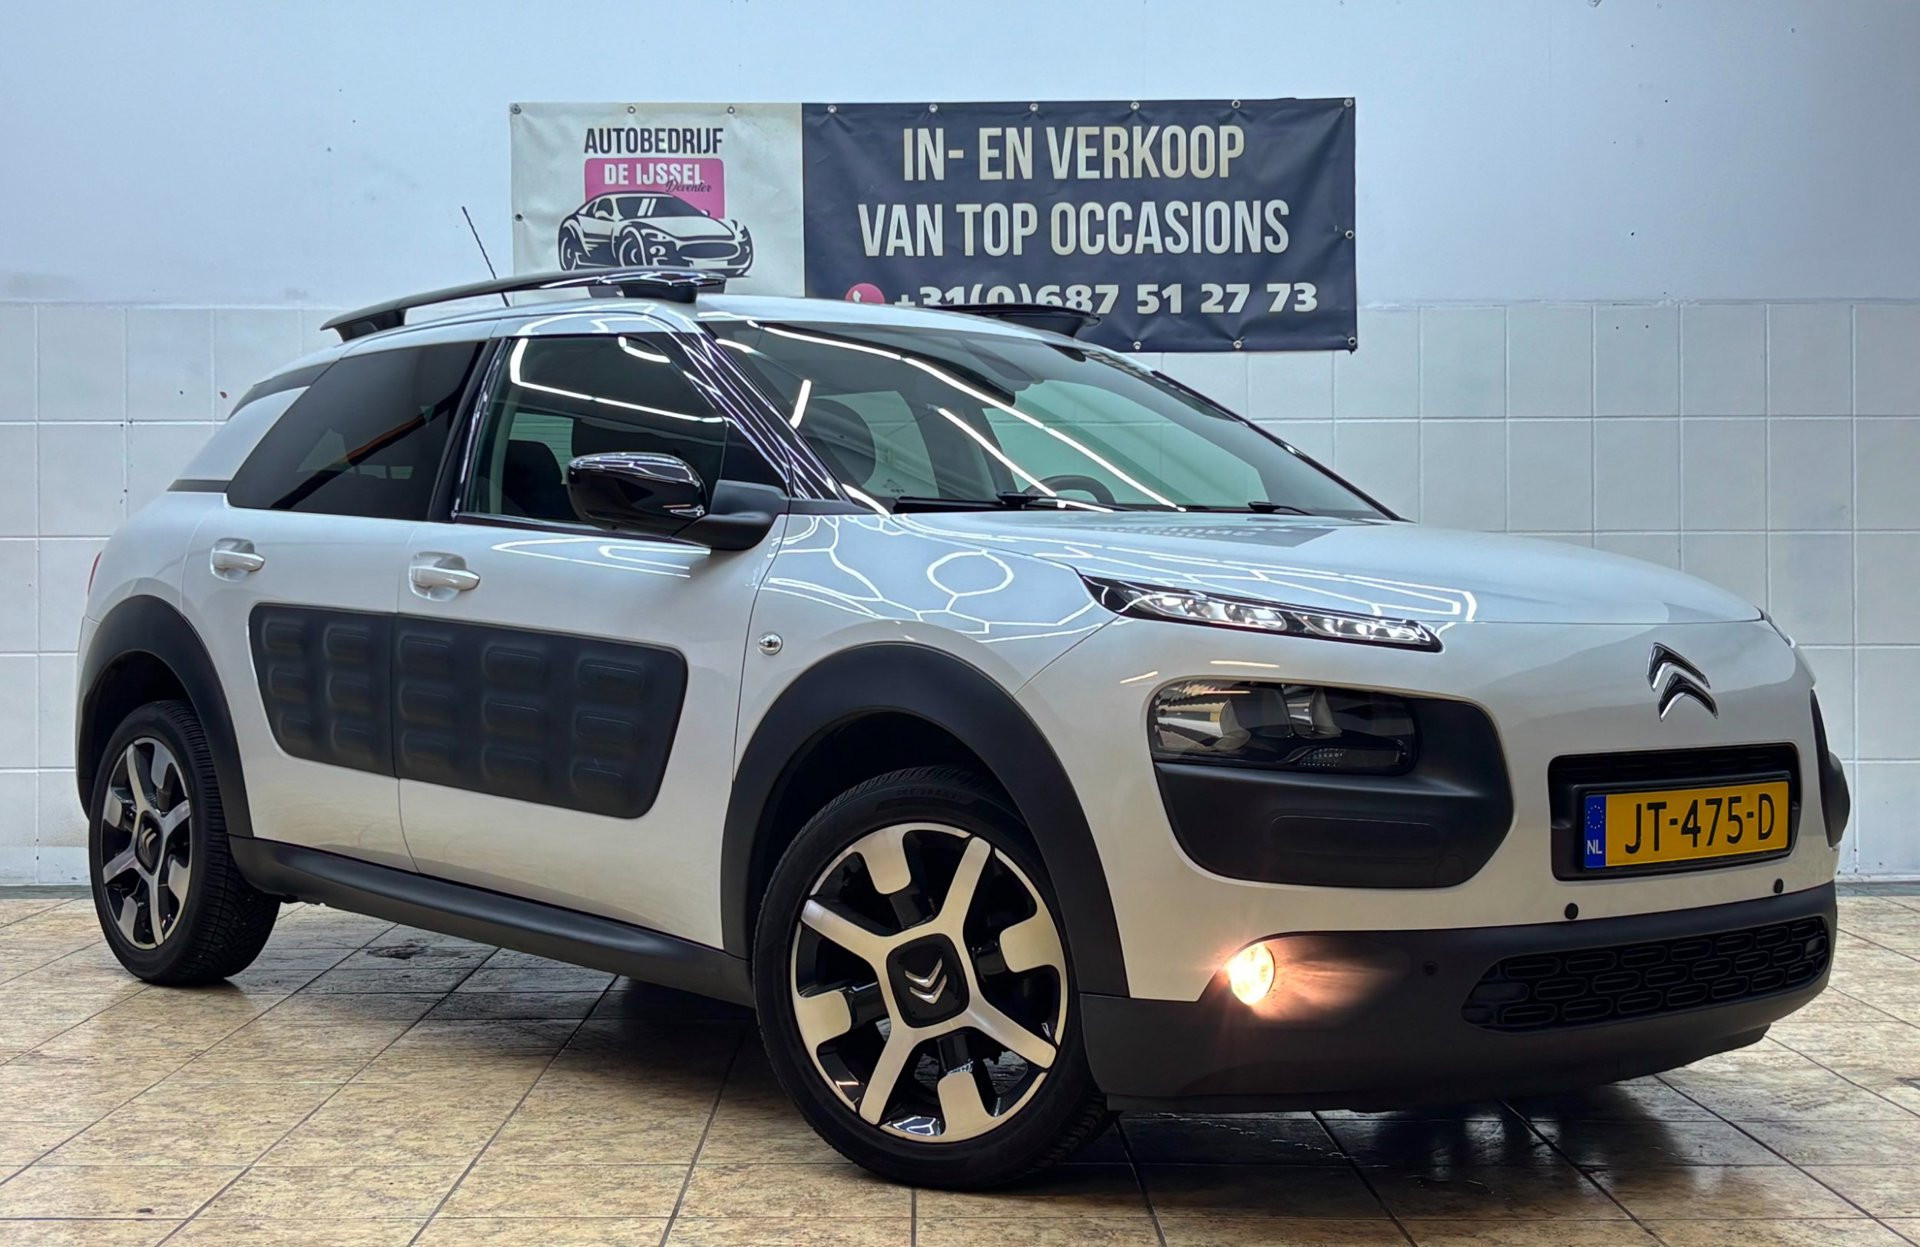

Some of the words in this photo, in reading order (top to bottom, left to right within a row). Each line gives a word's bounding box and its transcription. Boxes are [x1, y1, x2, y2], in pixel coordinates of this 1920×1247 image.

[584, 127, 724, 154] AUTOBEDRIJF
[903, 127, 964, 181] IN-
[978, 127, 1034, 180] EN
[1046, 124, 1245, 180] VERKOOP
[604, 163, 629, 185] DE
[636, 163, 705, 185] IJSSEL
[665, 178, 713, 194] Deventer
[857, 203, 943, 257] VAN
[956, 202, 1038, 257] TOP
[1050, 199, 1290, 255] OCCASIONS
[1136, 284, 1183, 315] 51
[1200, 283, 1251, 314] 27
[1266, 282, 1318, 313] 73
[1624, 793, 1775, 855] JT-475-D
[1586, 839, 1603, 855] NL
